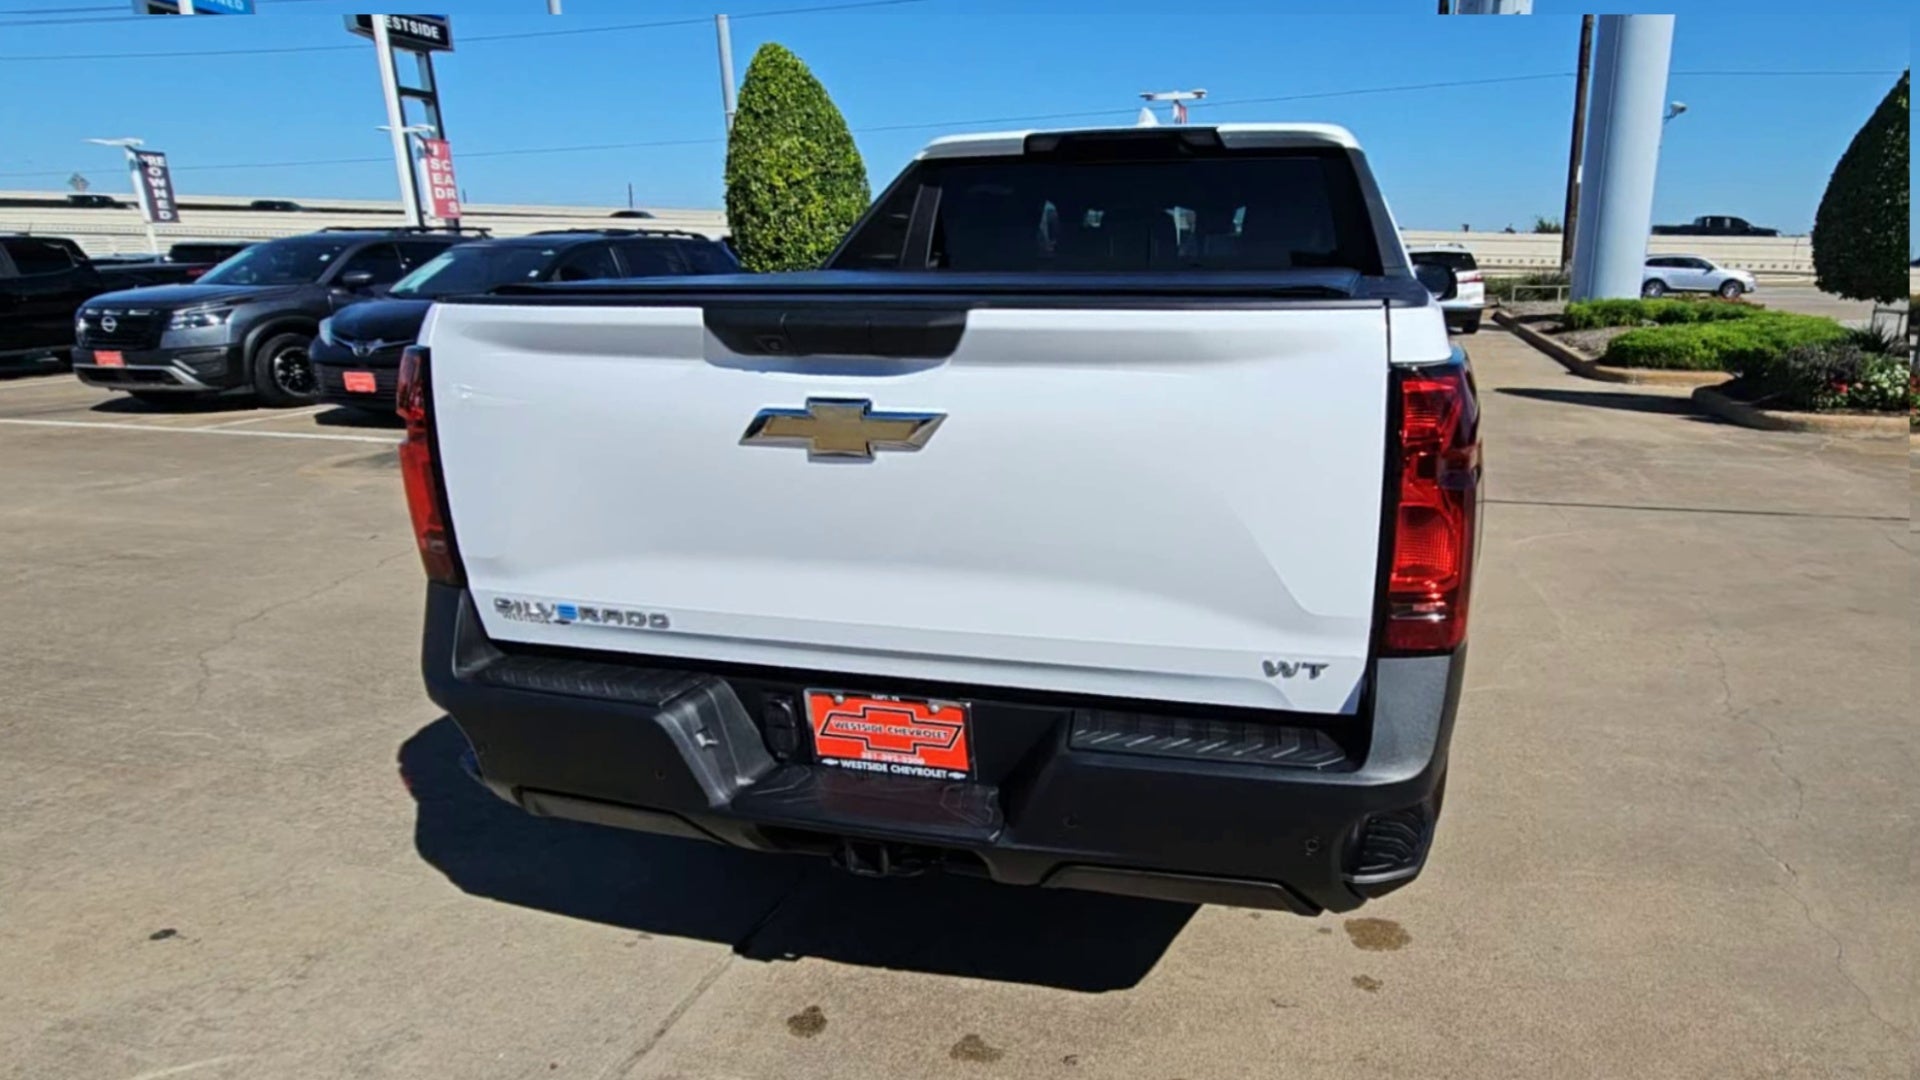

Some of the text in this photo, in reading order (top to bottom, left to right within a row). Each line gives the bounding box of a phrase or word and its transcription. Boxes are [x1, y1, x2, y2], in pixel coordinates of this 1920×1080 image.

[384, 16, 440, 39] ESTSIDE
[494, 597, 670, 629] SILVERADO
[1262, 659, 1330, 680] WT
[832, 720, 948, 739] WESTSIDE CHEVROLET
[840, 759, 949, 779] WESTSIDE CHEVROLET
